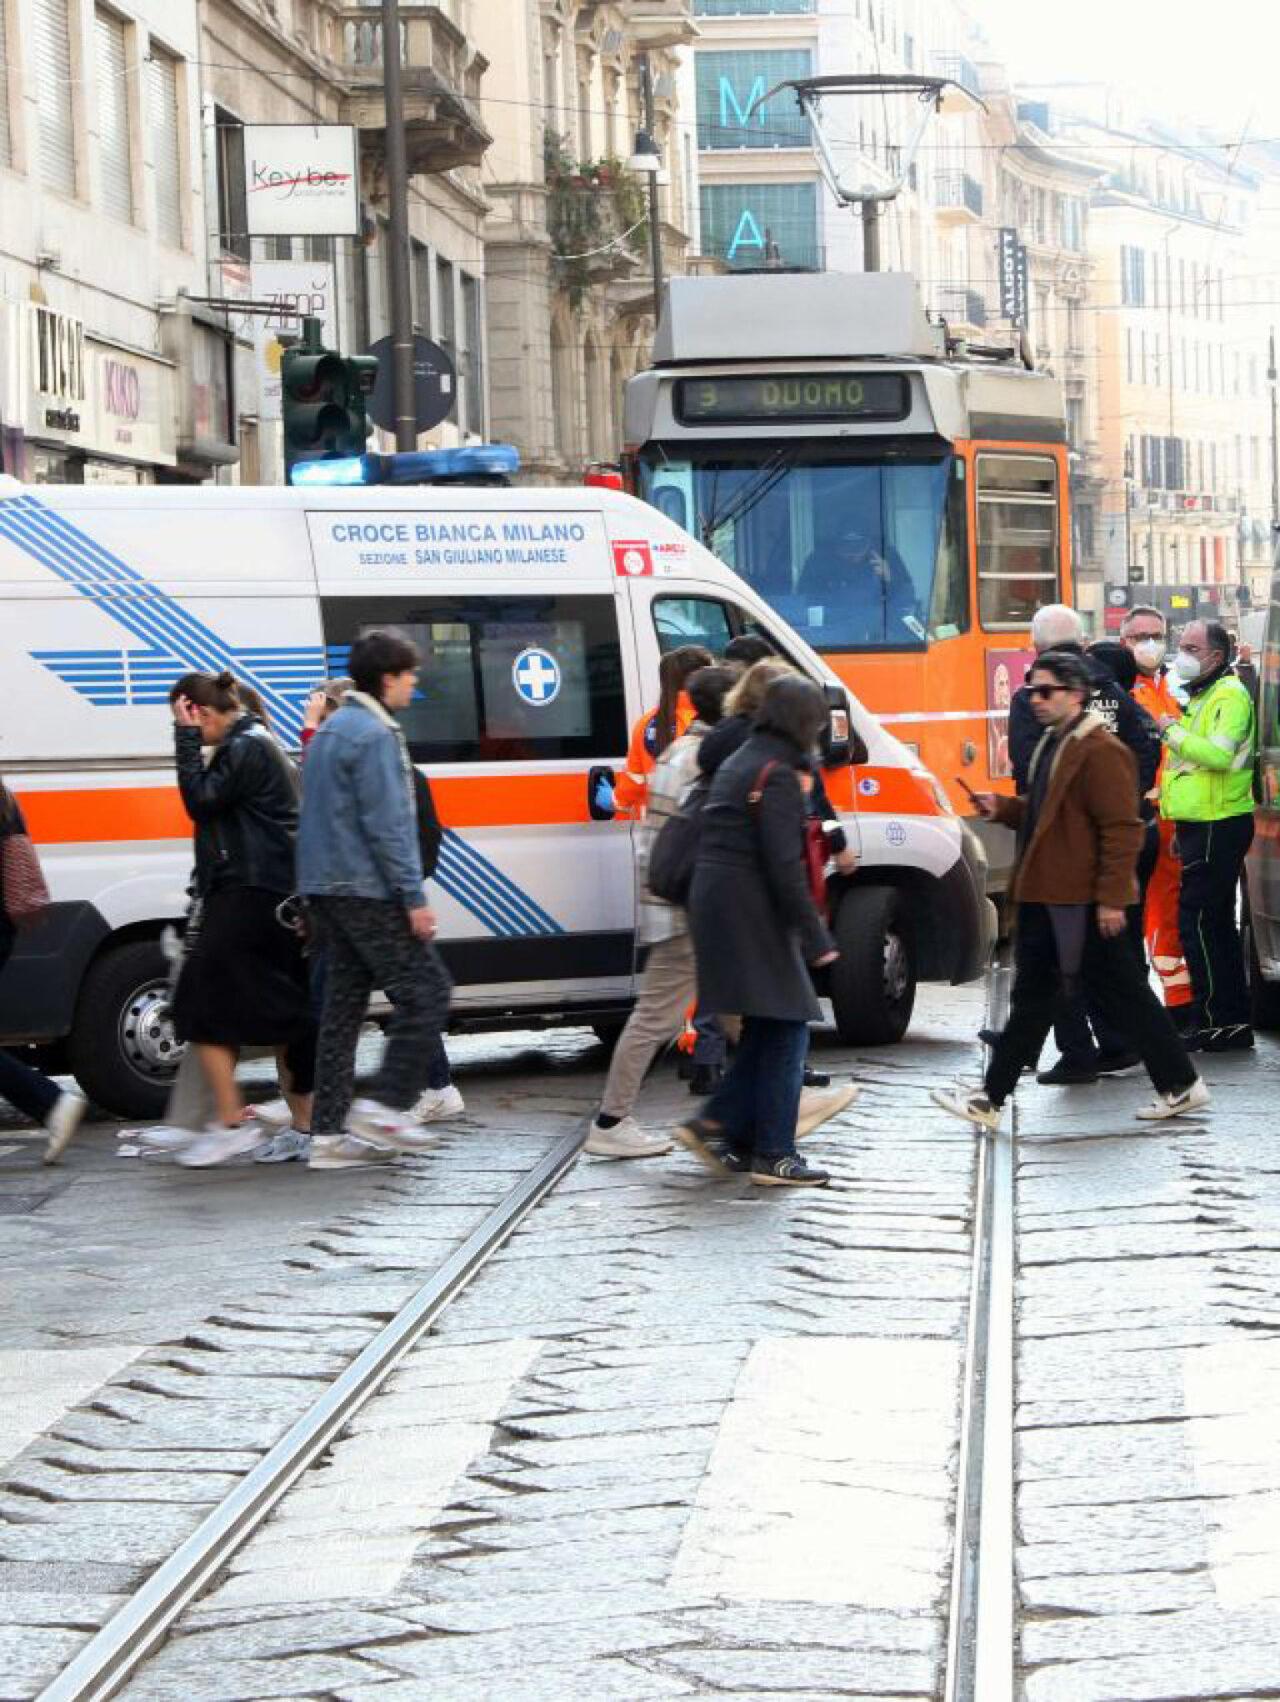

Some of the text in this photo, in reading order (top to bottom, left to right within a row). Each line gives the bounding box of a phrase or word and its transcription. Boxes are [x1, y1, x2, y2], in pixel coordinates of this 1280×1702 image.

[1003, 231, 1015, 315] ALCOTT
[701, 380, 866, 407] 3 DUOMO
[331, 523, 586, 543] CROCE BIANCA MILANO
[359, 548, 568, 565] SEZIONE SAN GIULIANO MILANESE
